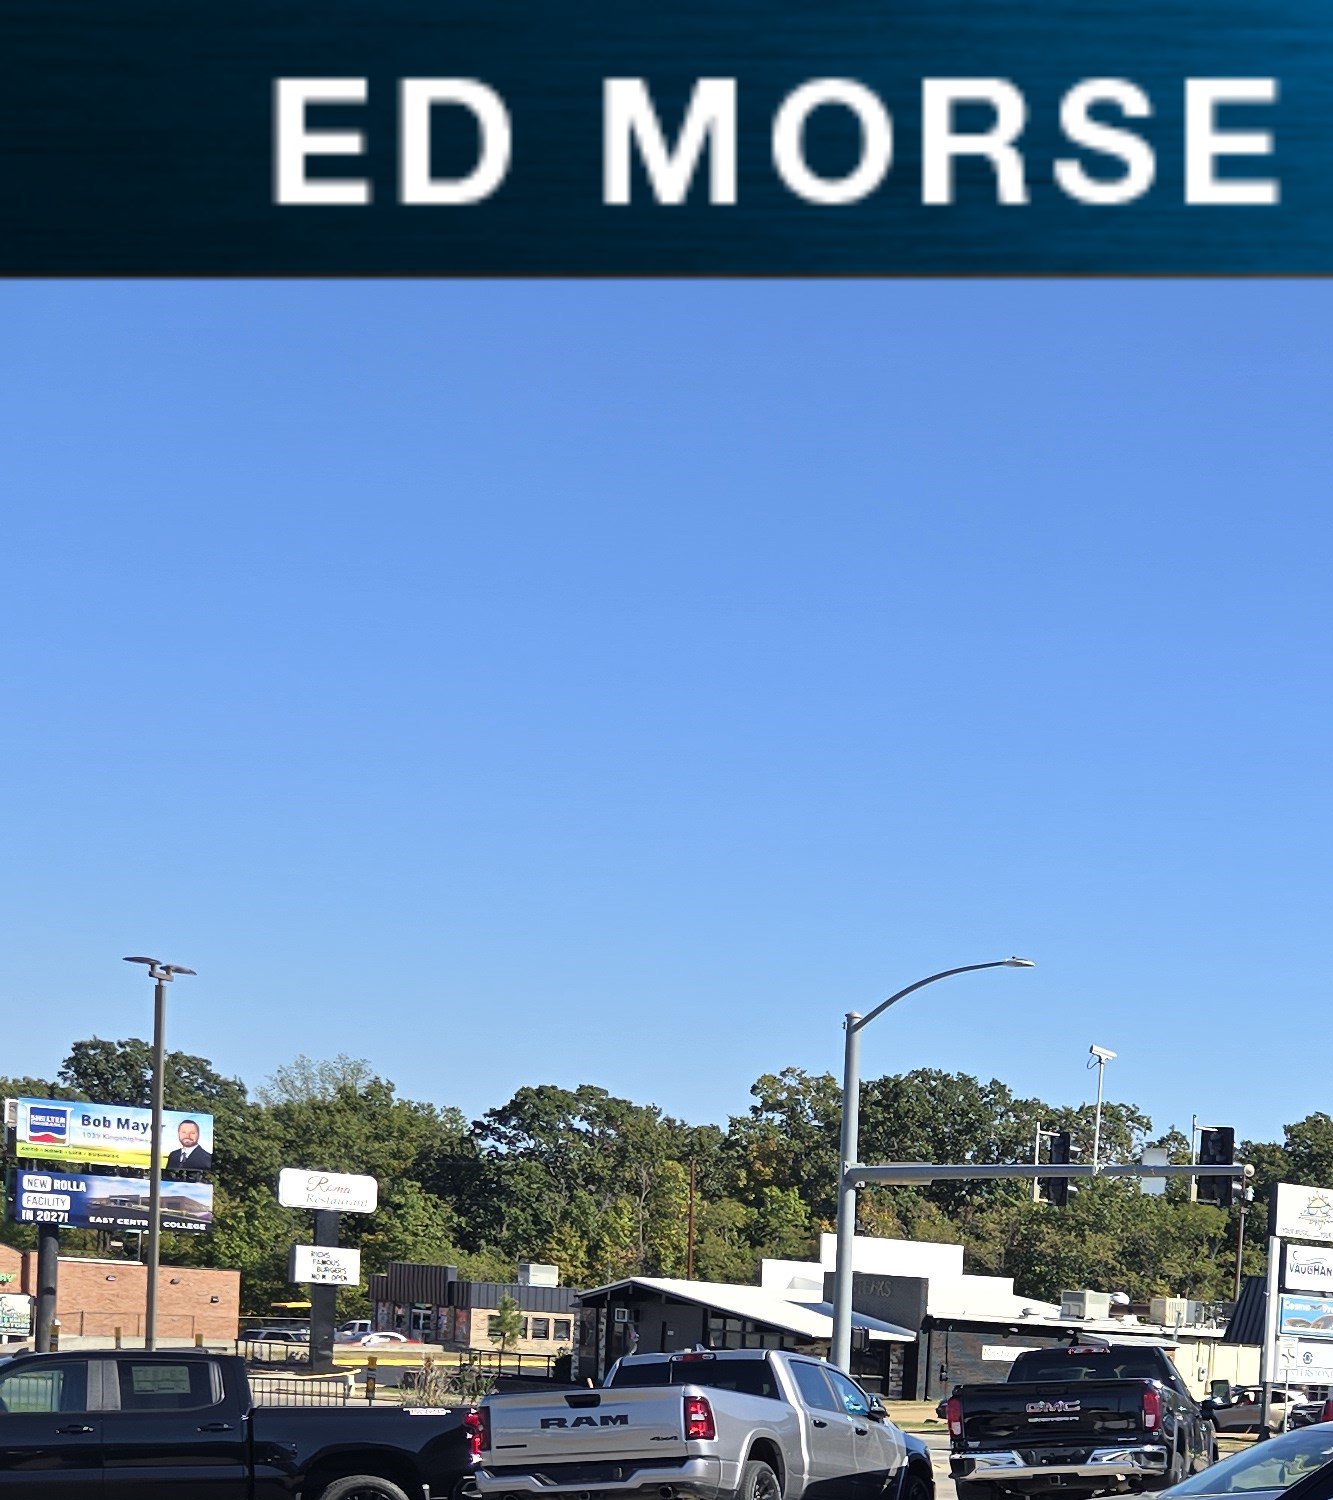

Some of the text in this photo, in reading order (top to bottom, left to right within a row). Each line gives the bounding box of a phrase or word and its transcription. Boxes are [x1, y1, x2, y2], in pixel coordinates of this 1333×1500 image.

[81, 1114, 112, 1129] Bob
[27, 1178, 87, 1193] NEW ROLLA
[26, 1196, 67, 1208] FACILITY
[21, 1210, 69, 1223] IN 2027!
[162, 1220, 207, 1231] COLLEGE
[1288, 1262, 1333, 1277] VAUGHAN
[1026, 1400, 1081, 1413] GMC
[540, 1414, 629, 1430] RAM
